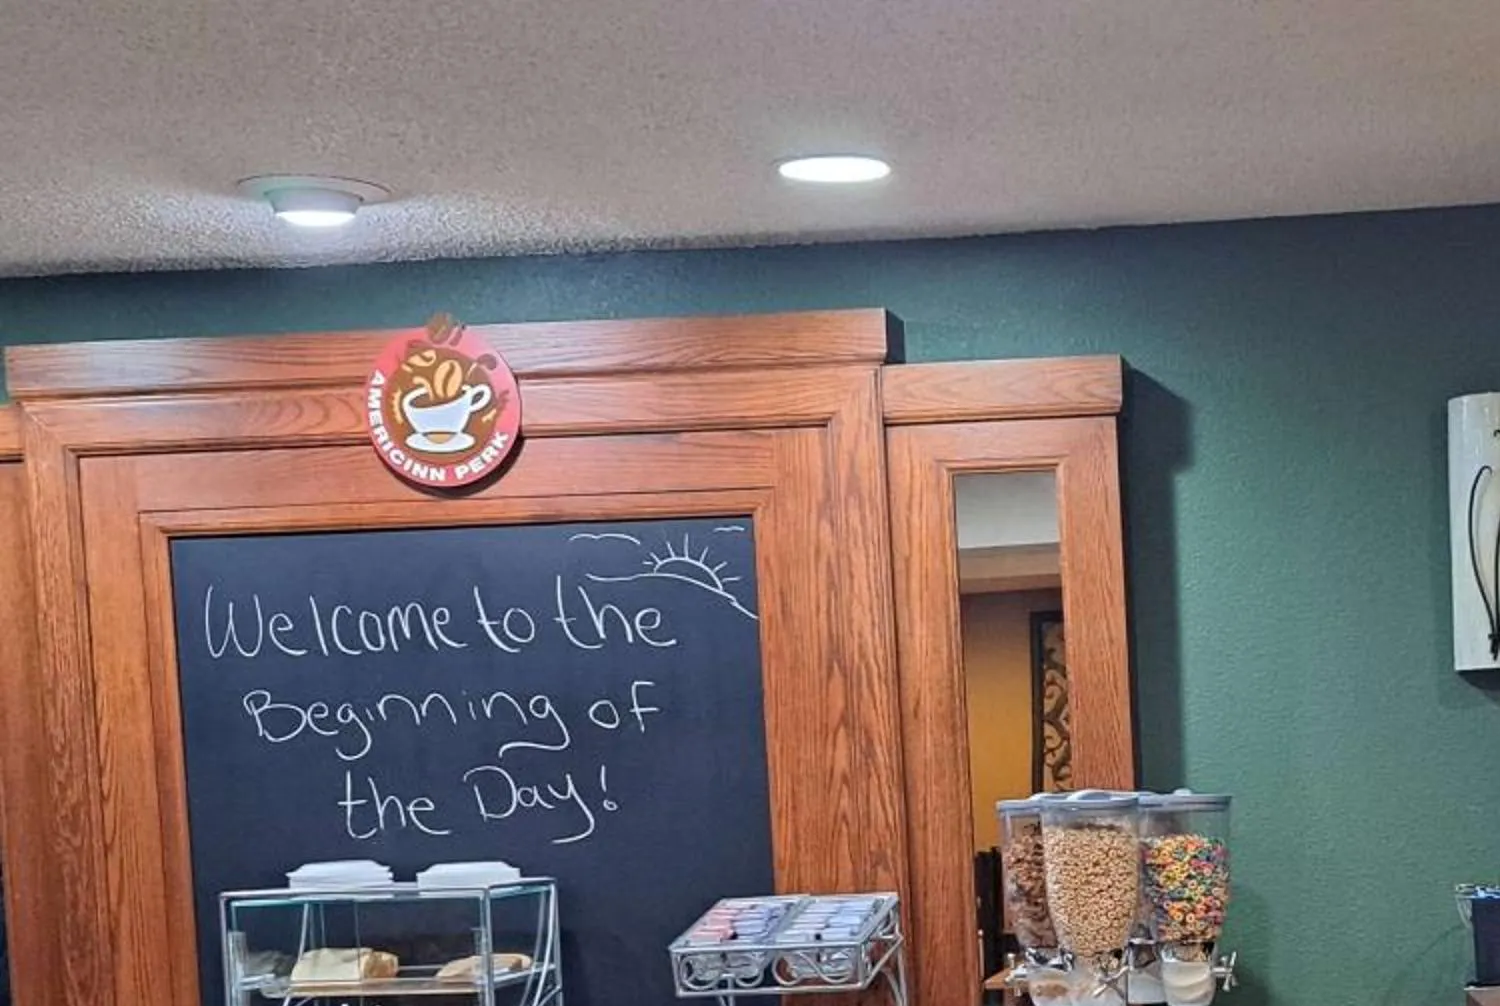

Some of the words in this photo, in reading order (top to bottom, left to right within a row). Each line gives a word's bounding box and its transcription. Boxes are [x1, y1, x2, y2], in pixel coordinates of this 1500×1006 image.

[367, 368, 446, 482] AMERICINN
[454, 430, 509, 480] PERK
[204, 584, 468, 659] Welcome
[473, 585, 536, 653] to
[554, 574, 677, 650] the
[587, 680, 659, 733] of
[337, 770, 451, 839] the
[463, 764, 619, 844] Day!
